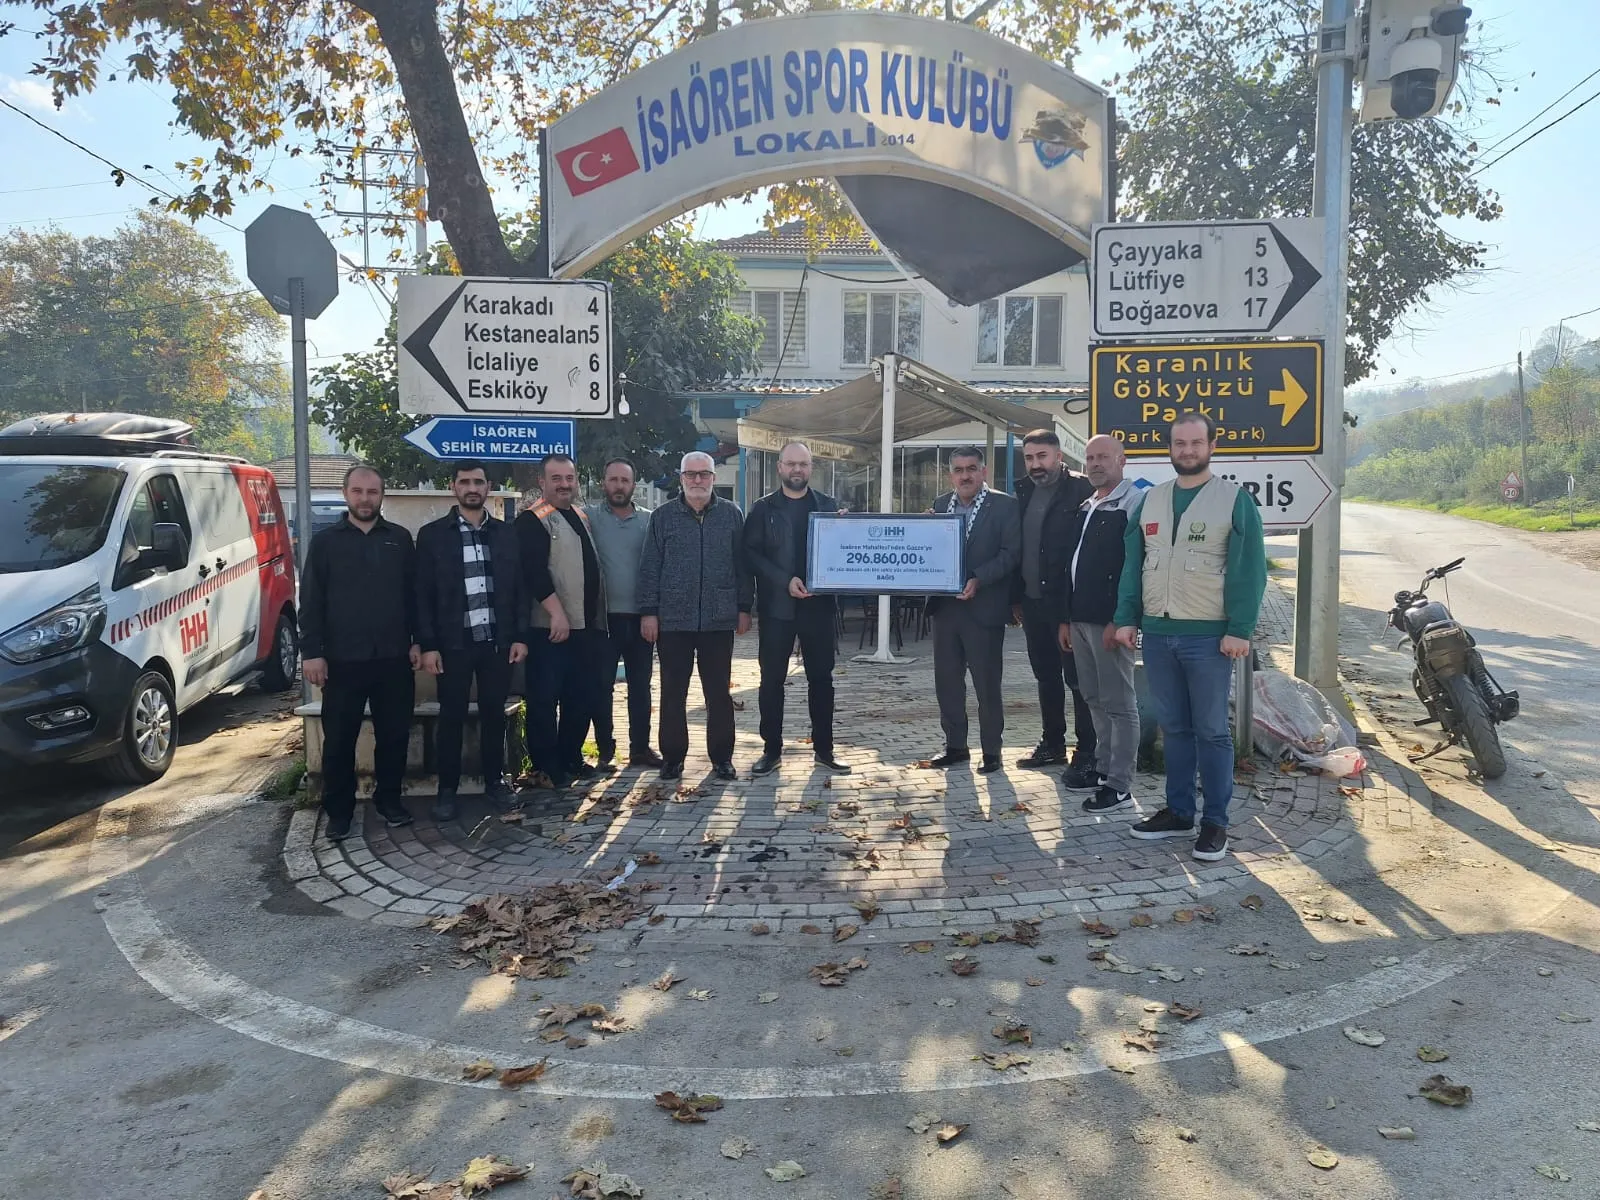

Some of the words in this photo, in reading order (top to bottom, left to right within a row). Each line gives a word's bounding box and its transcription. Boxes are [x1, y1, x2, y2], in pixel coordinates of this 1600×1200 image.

[636, 55, 775, 173] İSAÖREN
[784, 47, 869, 118] SPOR
[880, 50, 1014, 141] KULÜBÜ
[734, 122, 876, 157] LOKALİ
[1108, 239, 1202, 266] Çayyaka
[1255, 237, 1267, 258] 5
[1109, 270, 1185, 294] Lütfiye
[1244, 267, 1268, 287] 13
[463, 294, 553, 316] Karakadı
[587, 296, 599, 316] 4
[1109, 299, 1218, 325] Boğazova
[1243, 297, 1268, 318] 17
[464, 323, 588, 345] Kestanealan
[589, 324, 600, 344] 5
[467, 346, 538, 376] İclaliye
[589, 353, 599, 372] 6
[1116, 351, 1253, 374] Karanlık
[468, 379, 548, 404] Eskiköy
[589, 381, 600, 401] 8
[1113, 377, 1253, 403] Gökyüzü
[473, 424, 537, 438] İSAÖREN
[1216, 427, 1265, 442] Park)
[441, 440, 486, 455] ŞEHİR
[490, 440, 569, 455] MEZARLIĞI
[1221, 473, 1294, 513] RİŞ
[1506, 489, 1516, 497] 30
